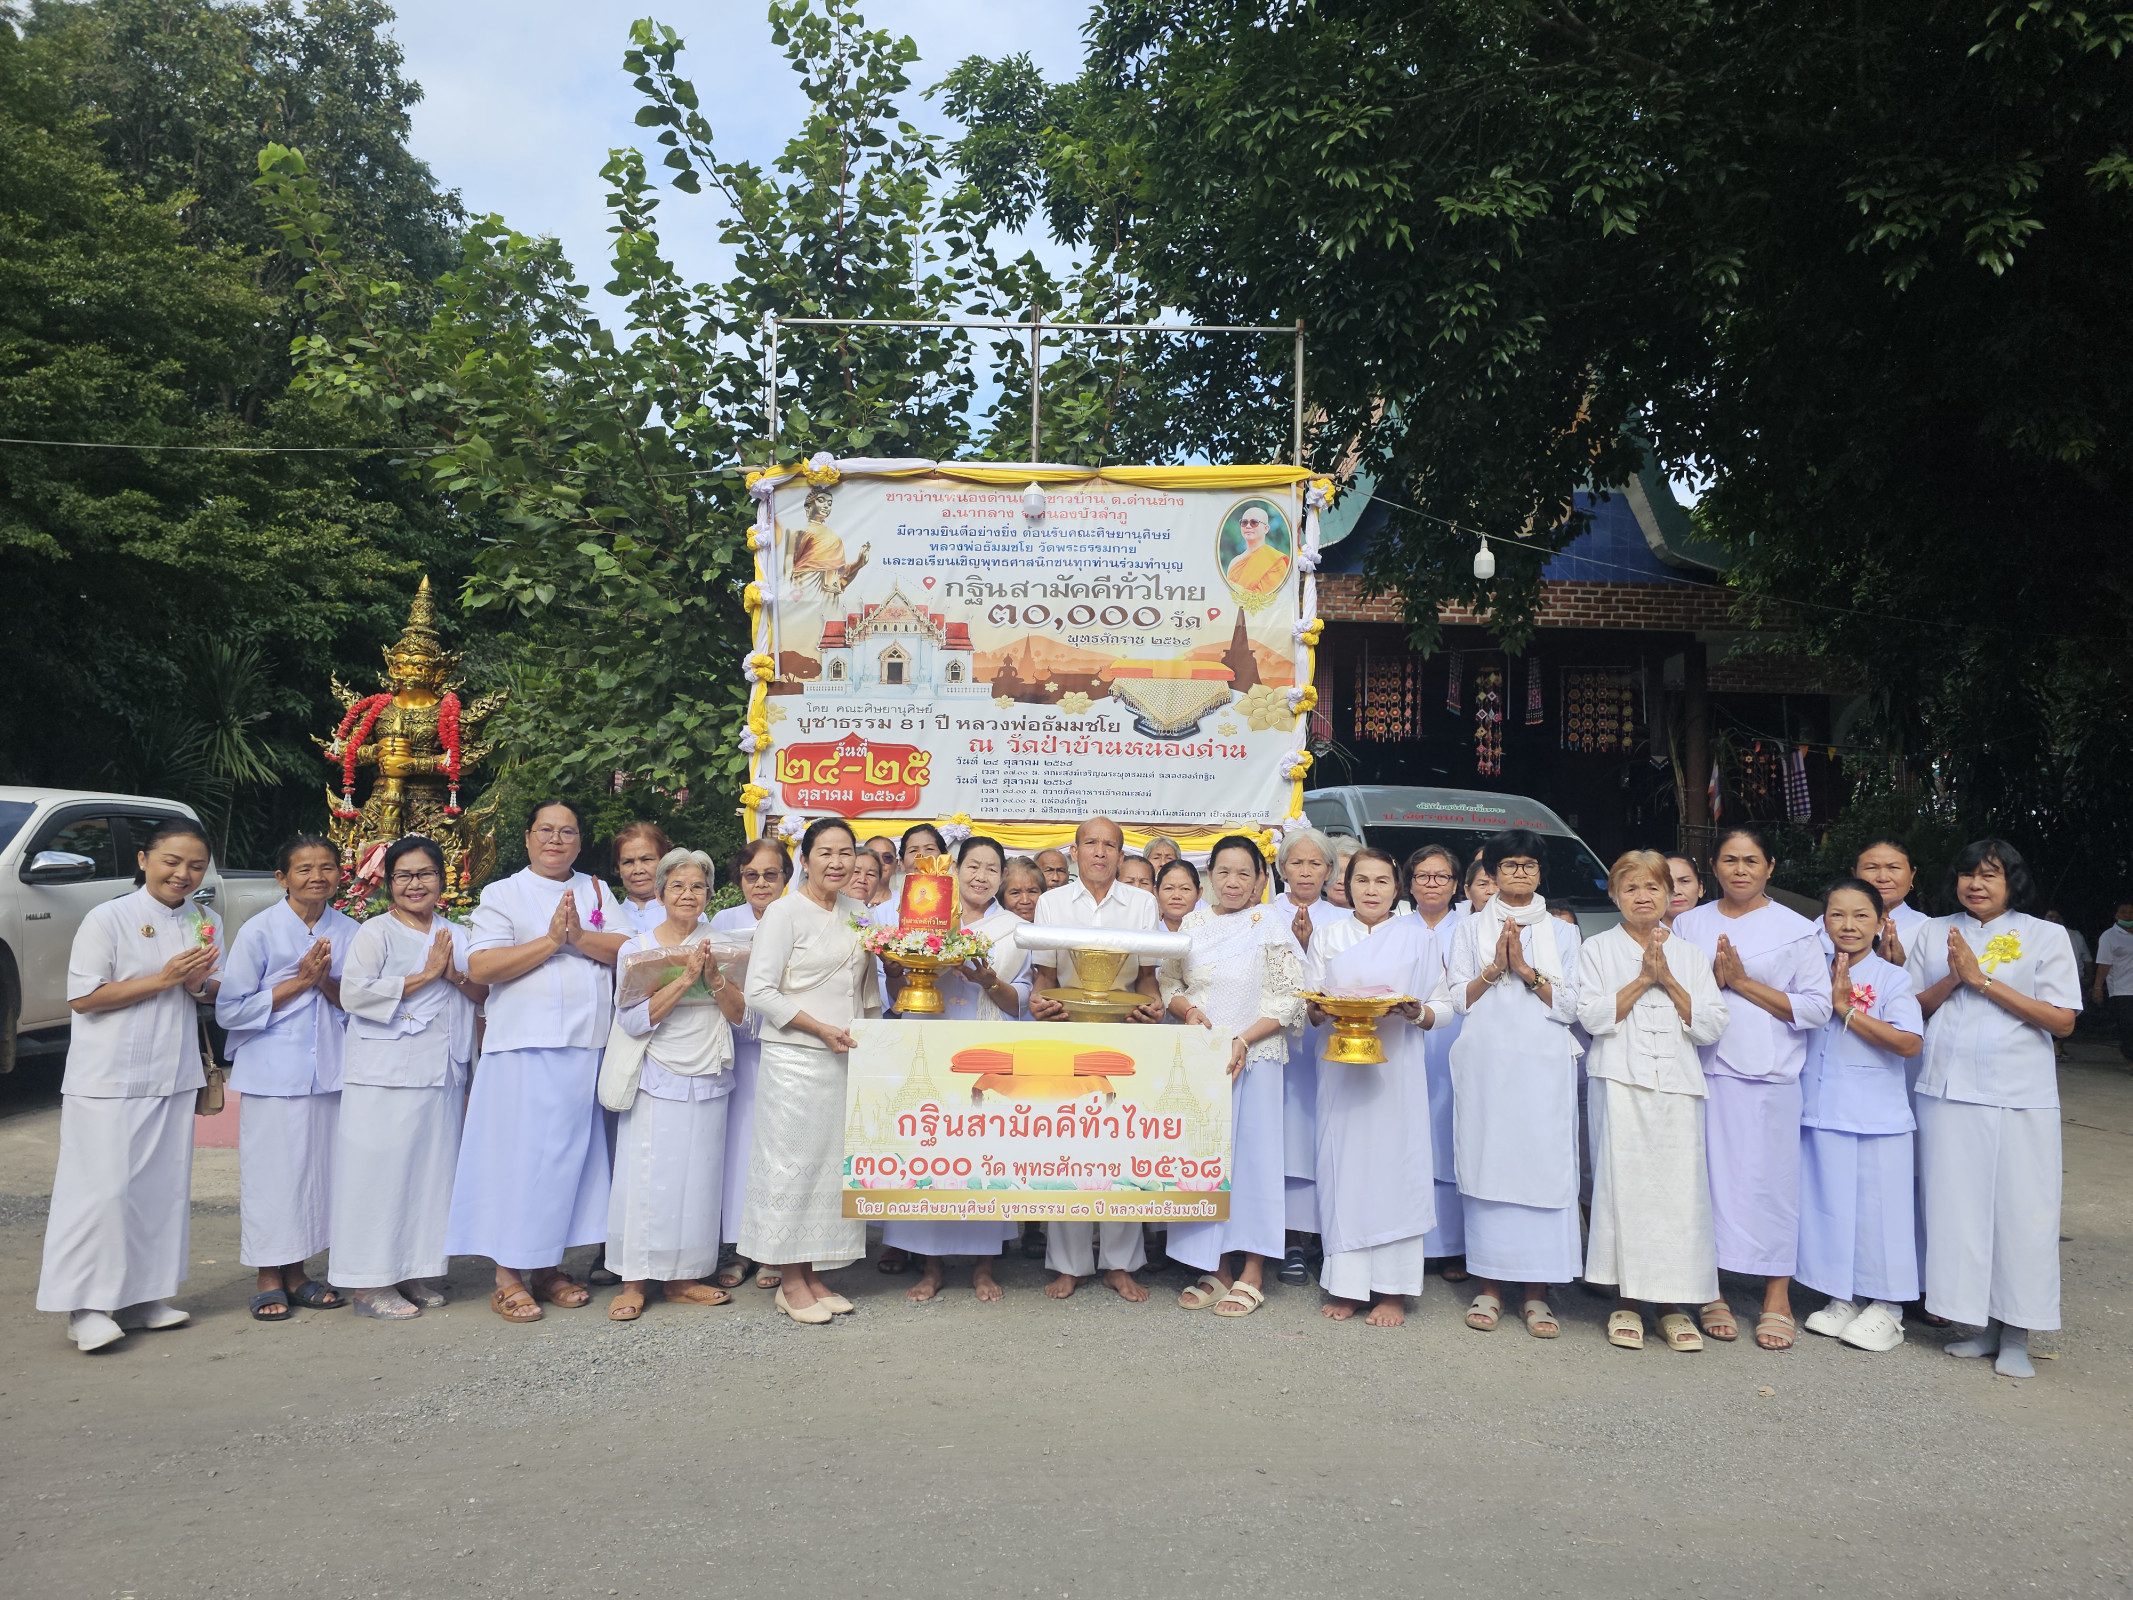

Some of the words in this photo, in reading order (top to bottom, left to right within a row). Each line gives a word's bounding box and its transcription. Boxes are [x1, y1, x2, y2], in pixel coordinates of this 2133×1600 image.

[886, 490, 1105, 504] ชาวบ้านหนองด่านชาวบ้าน
[942, 508, 1014, 519] อ.นากลาง
[897, 523, 1017, 537] มีความยินดีอย่างยิ่ง
[1023, 526, 1170, 543] ต้อนรับคณะศิษยานุศิษย์
[929, 540, 1033, 552] หลวงพ่อธัมมชโย
[1038, 541, 1137, 554] วัดพระธรรมกาย
[882, 555, 1183, 574] และขอเรียนเชิญพุทธศาสนิกชนทุกท่านร่วมทำบุญ
[945, 572, 1206, 605] กฐินสามัคคีทั่วไทย
[988, 603, 1162, 632] ๓๐,๐๐๐
[1170, 610, 1201, 629] วัด
[1067, 632, 1144, 647] พุทธศักราช
[1151, 635, 1192, 646] ๒๕๖๘
[806, 702, 829, 713] โดย
[836, 703, 933, 717] คณะศิษยานุศิษย์
[797, 717, 892, 734] บูชาธรรม
[900, 719, 925, 729] 81
[935, 713, 950, 730] ปี
[956, 714, 1120, 732] หลวงพ่อธัมมชโย
[836, 738, 869, 758] วันที่
[968, 738, 994, 754] ณ
[1006, 733, 1248, 759] วัดป่าบ้านหนองด่าน
[775, 749, 932, 786] ๒๔-๒๕
[955, 754, 979, 766] วันที่
[1003, 759, 1039, 768] ตุลาคม
[1044, 759, 1073, 767] ๒๕๖๘
[955, 773, 978, 785] วันที่
[1002, 777, 1039, 787] ตุลาคม
[1043, 778, 1073, 786] ๒๕๖๘
[797, 789, 853, 806] ตุลาคม
[861, 790, 906, 802] ๒๕๖๘
[897, 1095, 1182, 1147] กฐินสามัคคีทั่วไทย
[855, 1156, 972, 1180] ๓๐,๐๐๐
[981, 1154, 1006, 1176] วัด
[1013, 1156, 1121, 1184] พุทธศักราช
[1130, 1155, 1222, 1178] ๒๕๖๘
[857, 1199, 883, 1214] โดย
[888, 1199, 996, 1217] คณะศิษยานุศิษย์
[1001, 1202, 1065, 1218] บูชาธรรม
[1070, 1203, 1090, 1214] ๘๑
[1095, 1200, 1104, 1214] ปี
[1109, 1200, 1216, 1215] หลวงพ่อธัมมชโย
